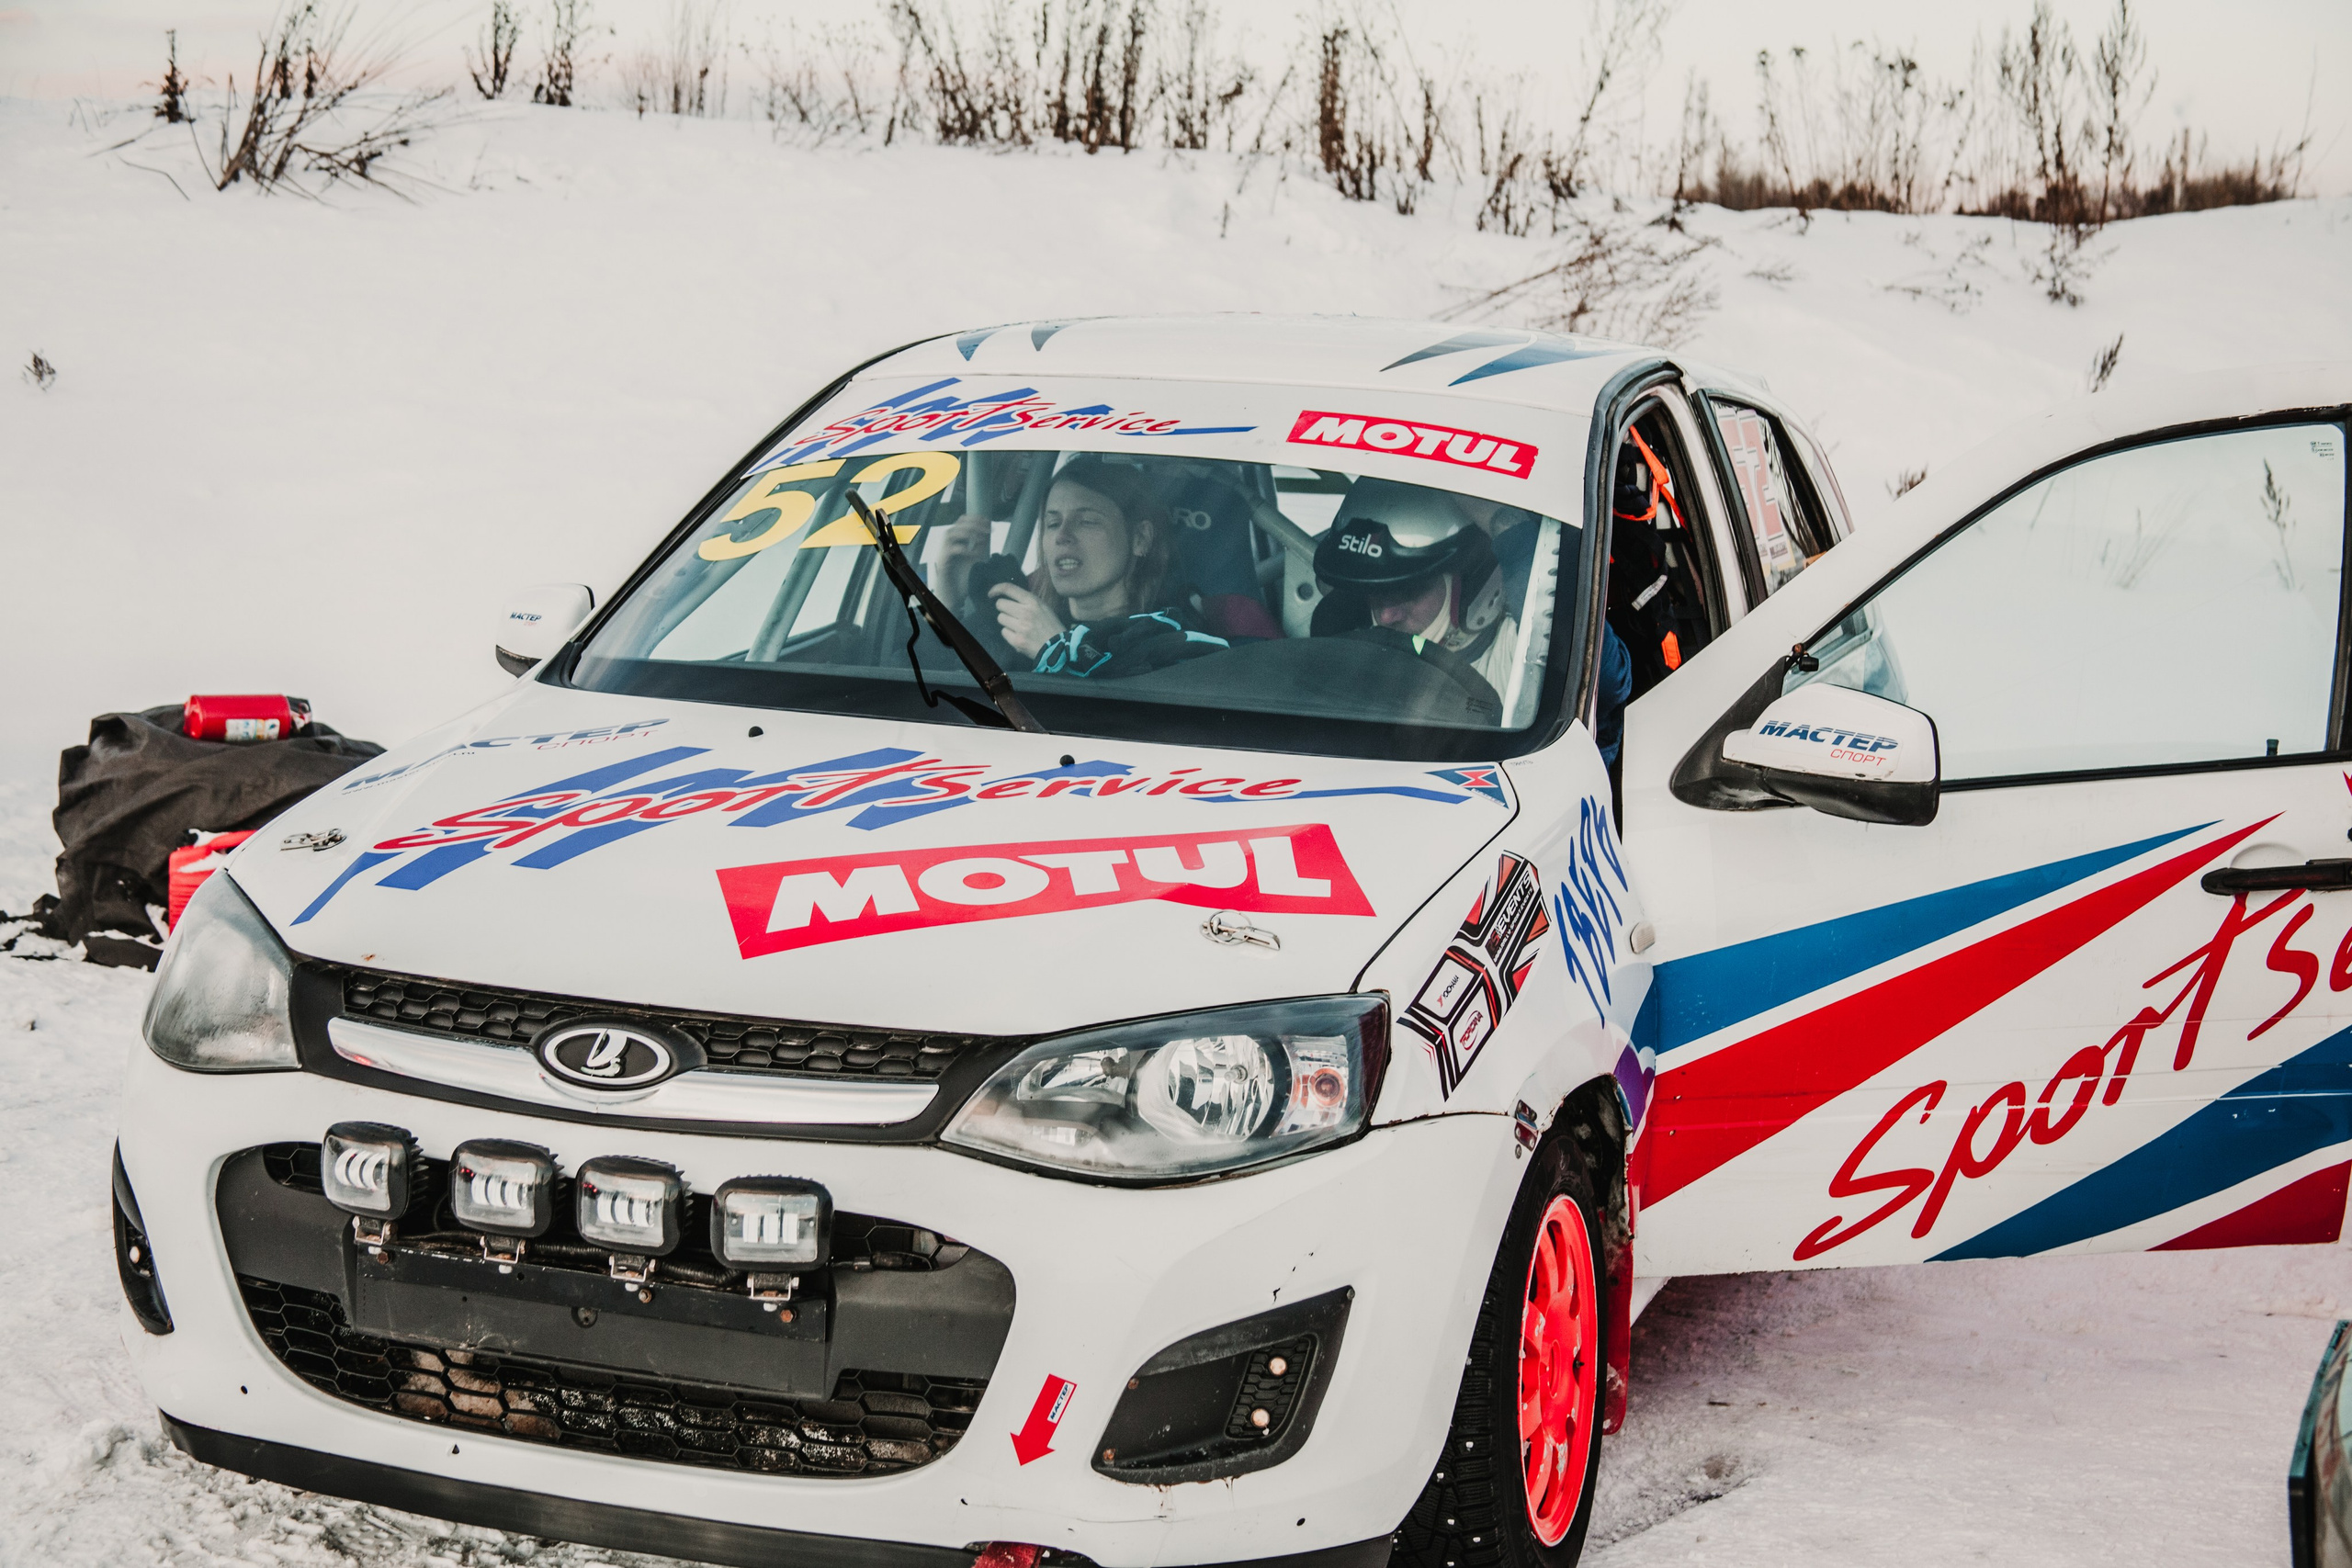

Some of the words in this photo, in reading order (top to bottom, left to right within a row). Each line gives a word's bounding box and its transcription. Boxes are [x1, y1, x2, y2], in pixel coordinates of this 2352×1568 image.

[1299, 416, 1521, 472] MOTUL
[701, 450, 961, 561] 52
[1758, 719, 1899, 753] МАСТЕР
[1830, 748, 1887, 767] СПОРТ
[765, 835, 1331, 933] MOTUL
[1497, 869, 1532, 934] EVENTS
